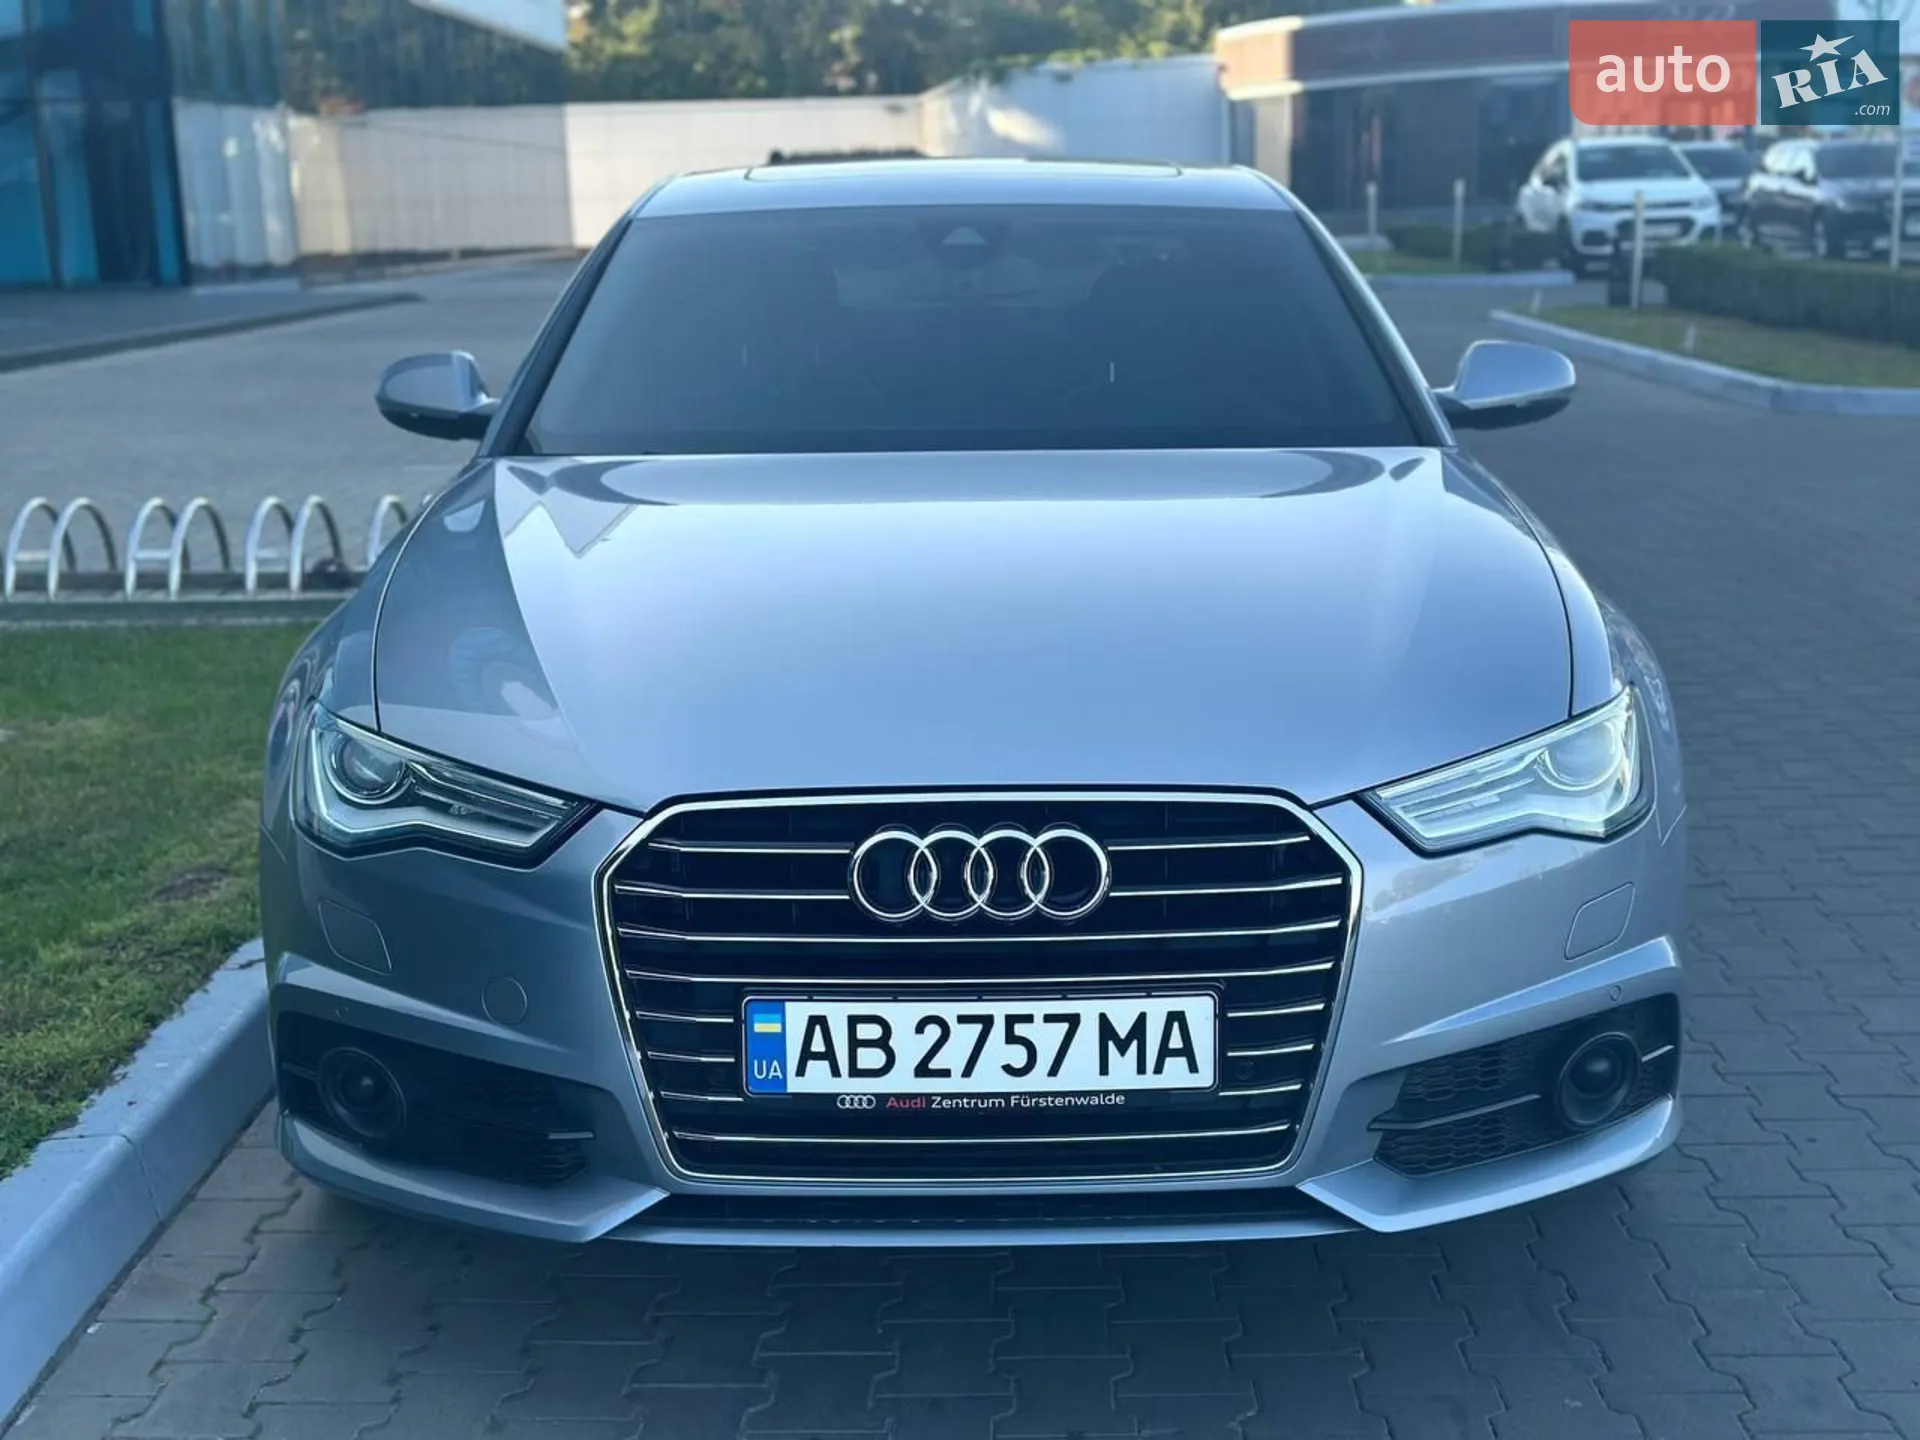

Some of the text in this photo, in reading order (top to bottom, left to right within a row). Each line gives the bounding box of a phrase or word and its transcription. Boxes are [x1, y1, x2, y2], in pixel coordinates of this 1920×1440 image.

[795, 1010, 1199, 1078] AB 2757 MA
[753, 1059, 783, 1080] UA
[886, 1092, 1125, 1110] Audi Zentrum Fürstenwalde
